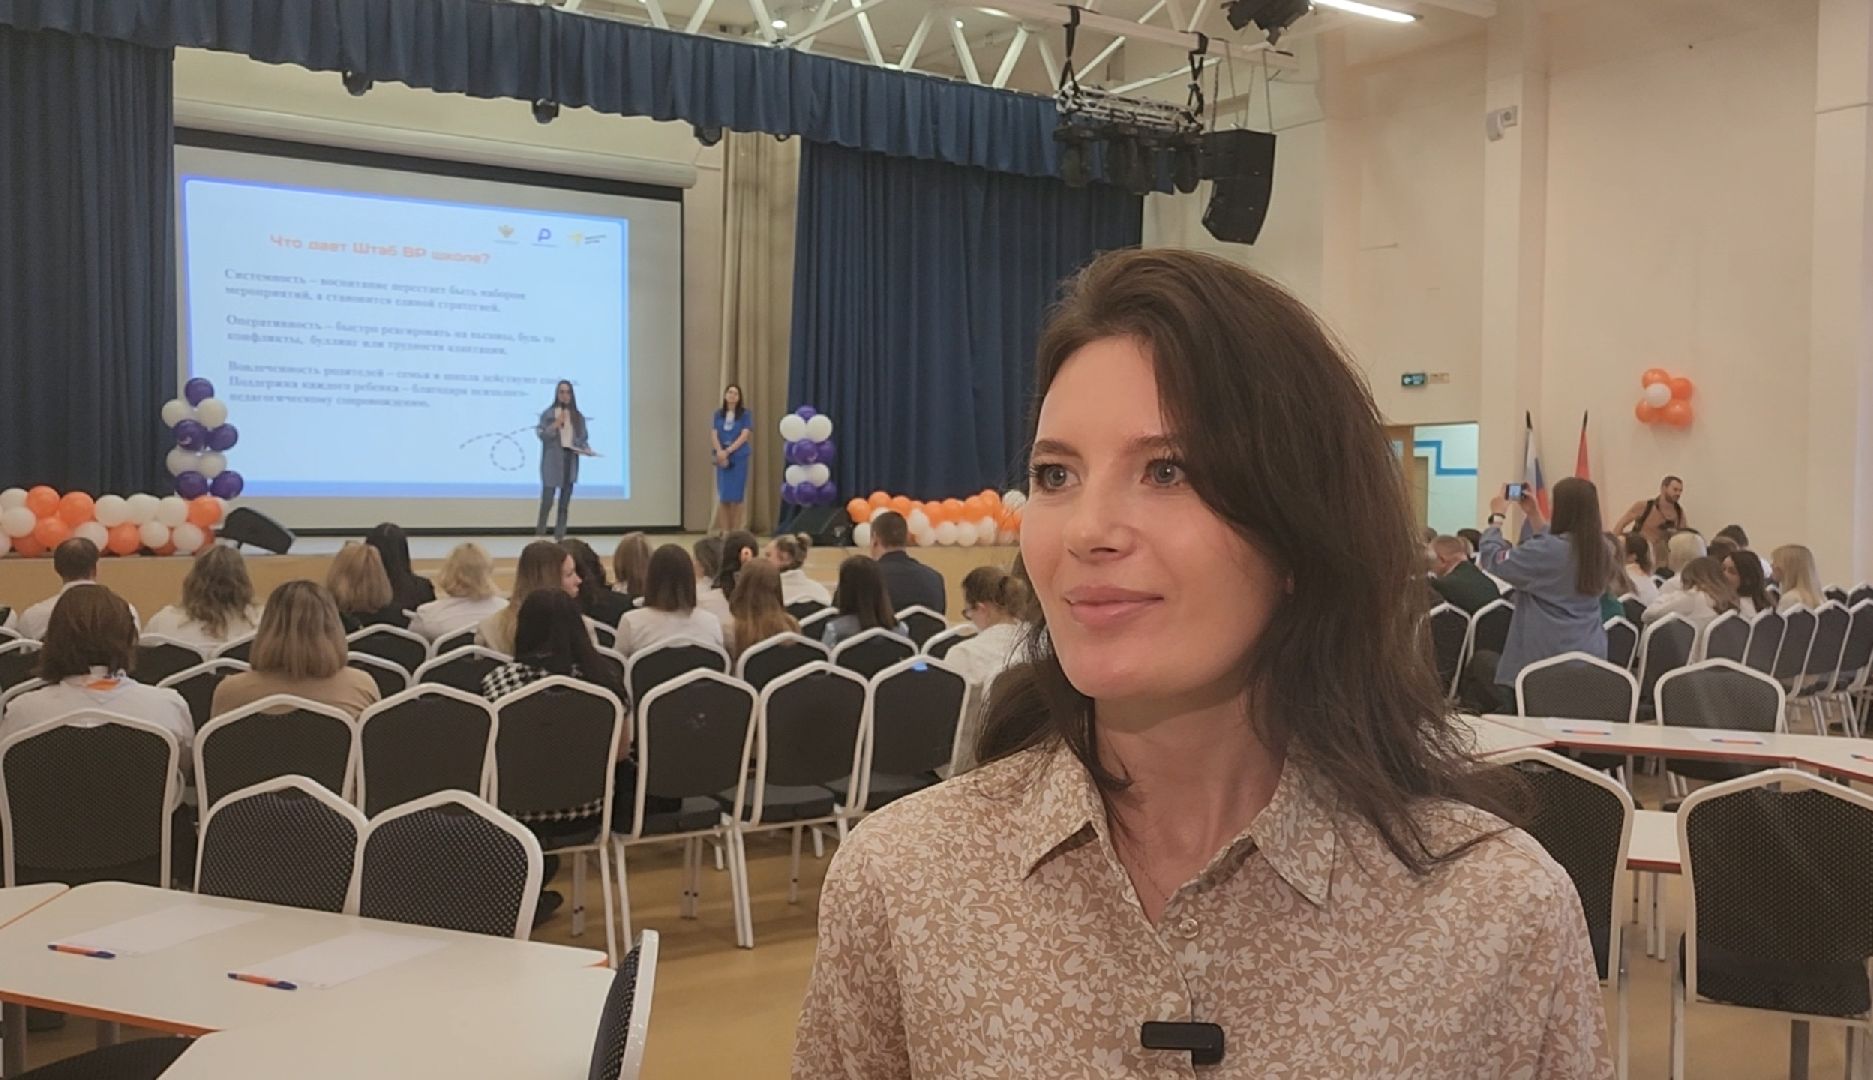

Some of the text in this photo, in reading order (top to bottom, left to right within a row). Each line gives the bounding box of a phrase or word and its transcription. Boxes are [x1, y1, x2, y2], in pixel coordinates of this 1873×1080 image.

[270, 233, 302, 249] Что
[352, 242, 398, 256] Штаб
[402, 245, 427, 258] ВР
[224, 268, 307, 284] Системность
[449, 284, 477, 297] быть
[224, 286, 314, 301] мероприятий,
[226, 313, 322, 331] Оперативность
[335, 321, 379, 335] быстро
[228, 375, 298, 390] Поддержка
